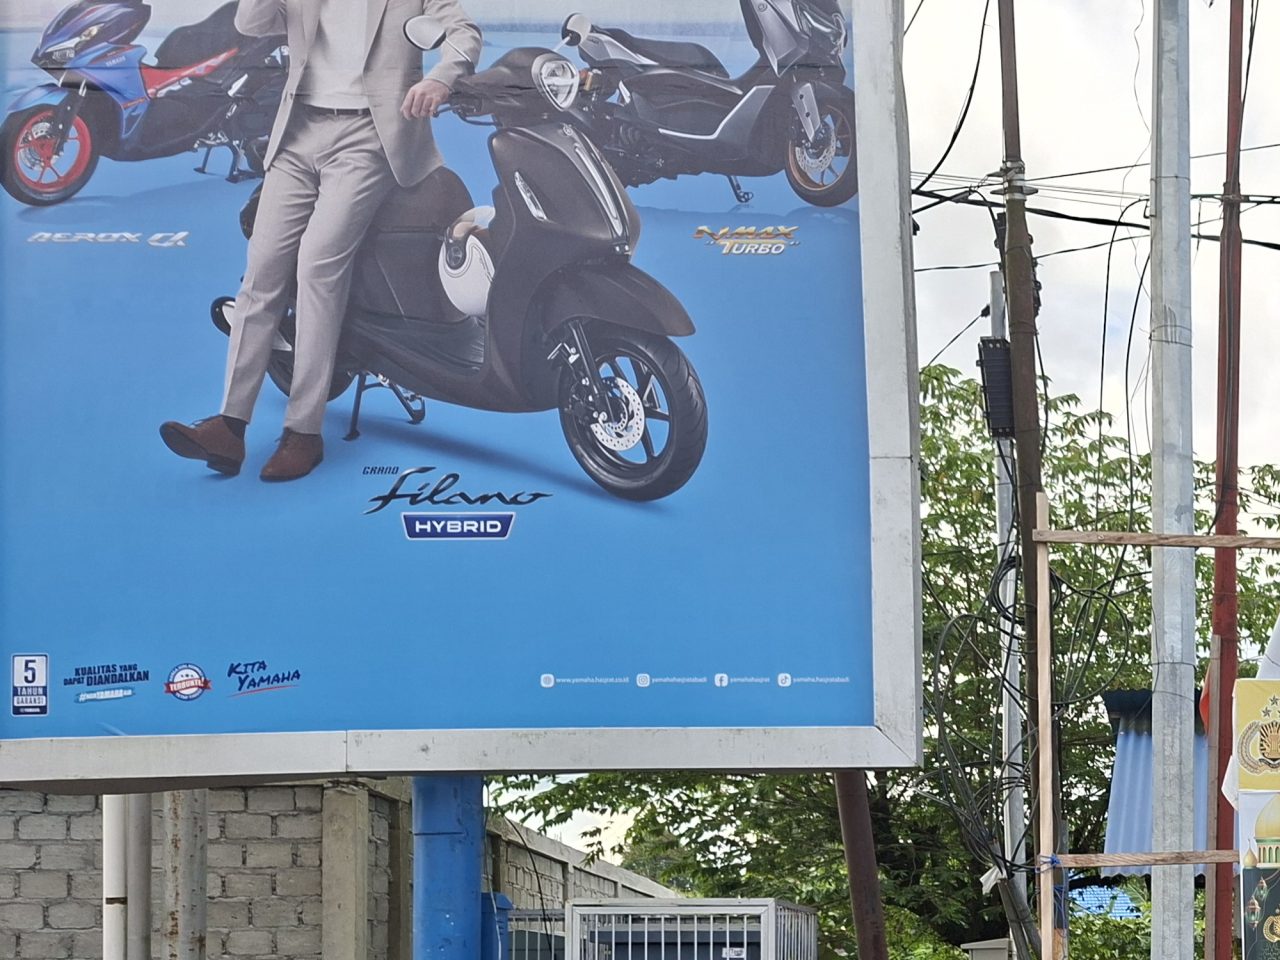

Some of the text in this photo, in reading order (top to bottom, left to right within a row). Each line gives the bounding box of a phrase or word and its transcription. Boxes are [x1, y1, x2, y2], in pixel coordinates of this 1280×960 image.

[362, 466, 399, 475] GRAND
[363, 466, 553, 515] Filano
[415, 520, 502, 533] HYBRID
[23, 659, 37, 684] 5
[74, 663, 138, 676] KUALITAS YANG
[227, 660, 268, 678] KITA
[86, 670, 150, 687] DIANDALKAN
[238, 669, 301, 692] YAMAHA
[17, 686, 44, 696] TAHUN
